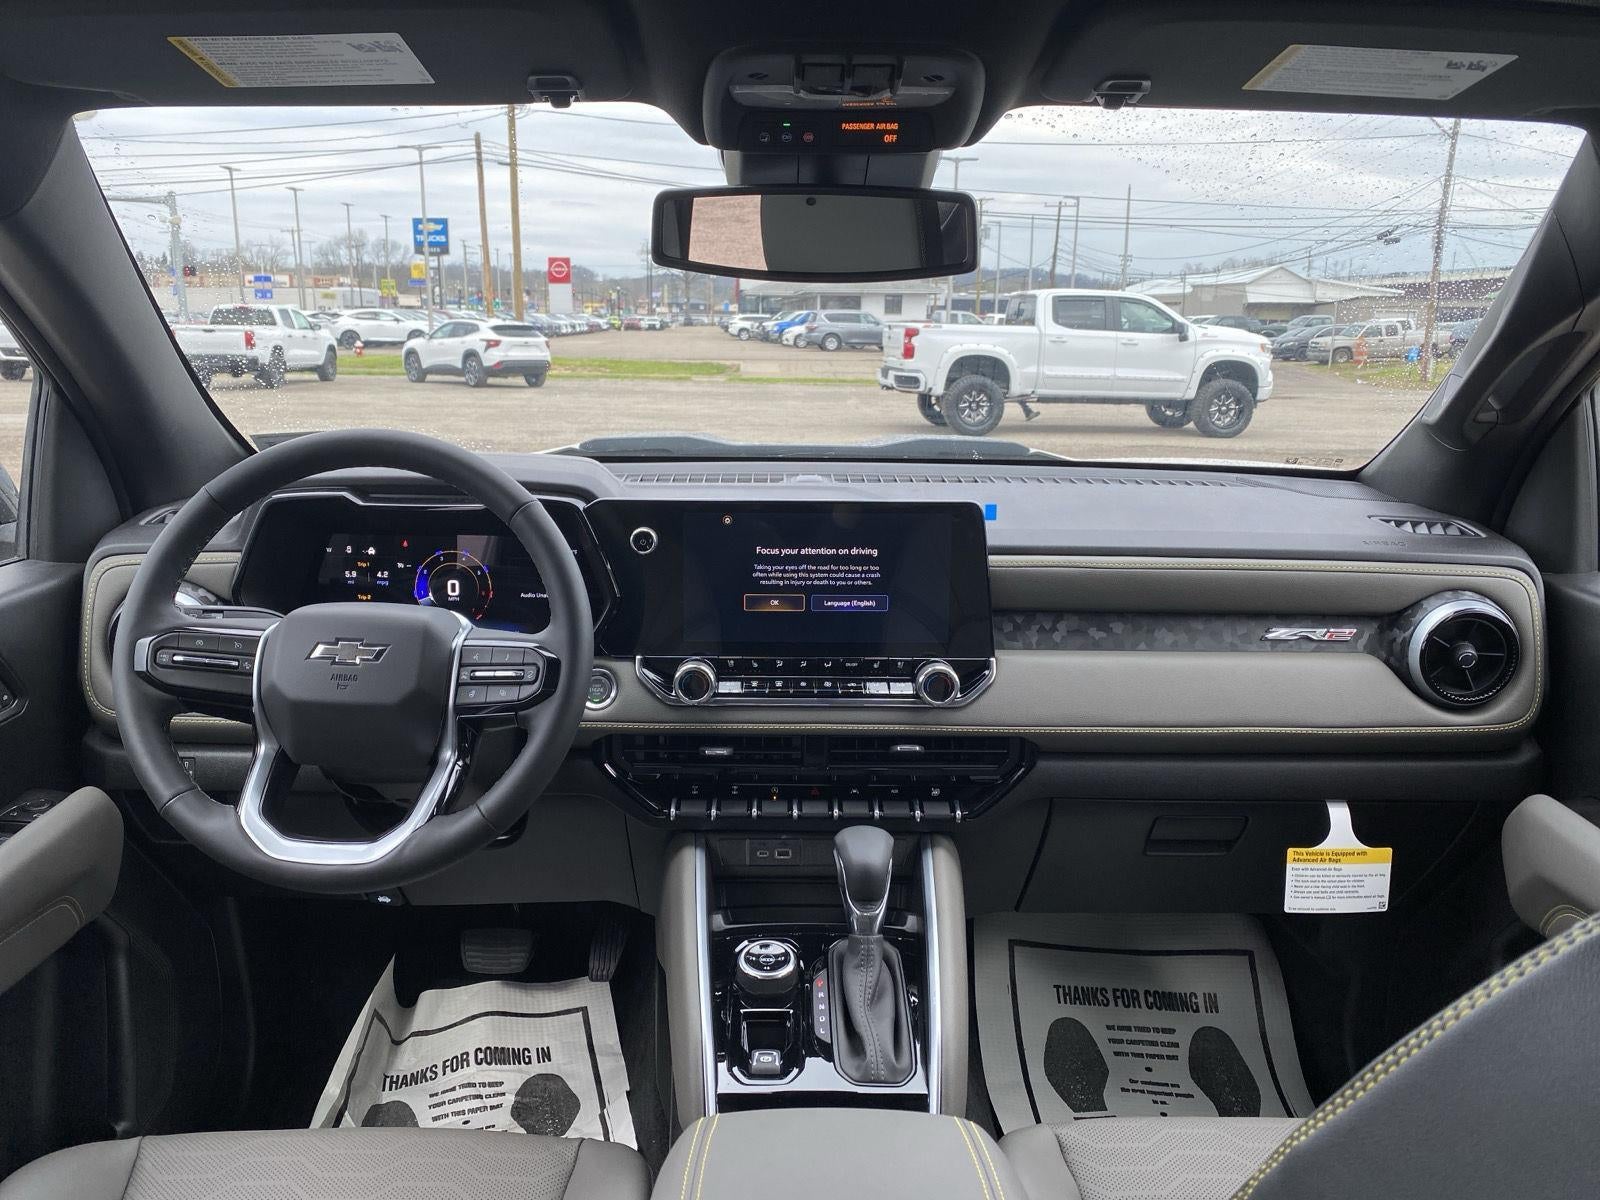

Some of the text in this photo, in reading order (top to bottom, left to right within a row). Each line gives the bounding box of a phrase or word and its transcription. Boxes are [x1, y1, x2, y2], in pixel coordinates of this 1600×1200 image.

[756, 547, 779, 555] Focus
[781, 548, 799, 557] your
[800, 547, 837, 555] attention
[850, 547, 878, 557] driving
[447, 580, 460, 596] 0
[1260, 628, 1357, 641] ZR2
[330, 673, 358, 682] AIRBAG
[1053, 984, 1220, 1014] THANKS FOR COMING IN
[382, 1046, 552, 1092] THANKS FOR COMING IN
[428, 1101, 446, 1110] YOUR
[448, 1094, 483, 1105] CARPETING
[432, 1113, 449, 1122] WITH
[451, 1109, 466, 1118] THIS
[467, 1105, 488, 1115] PAPER
